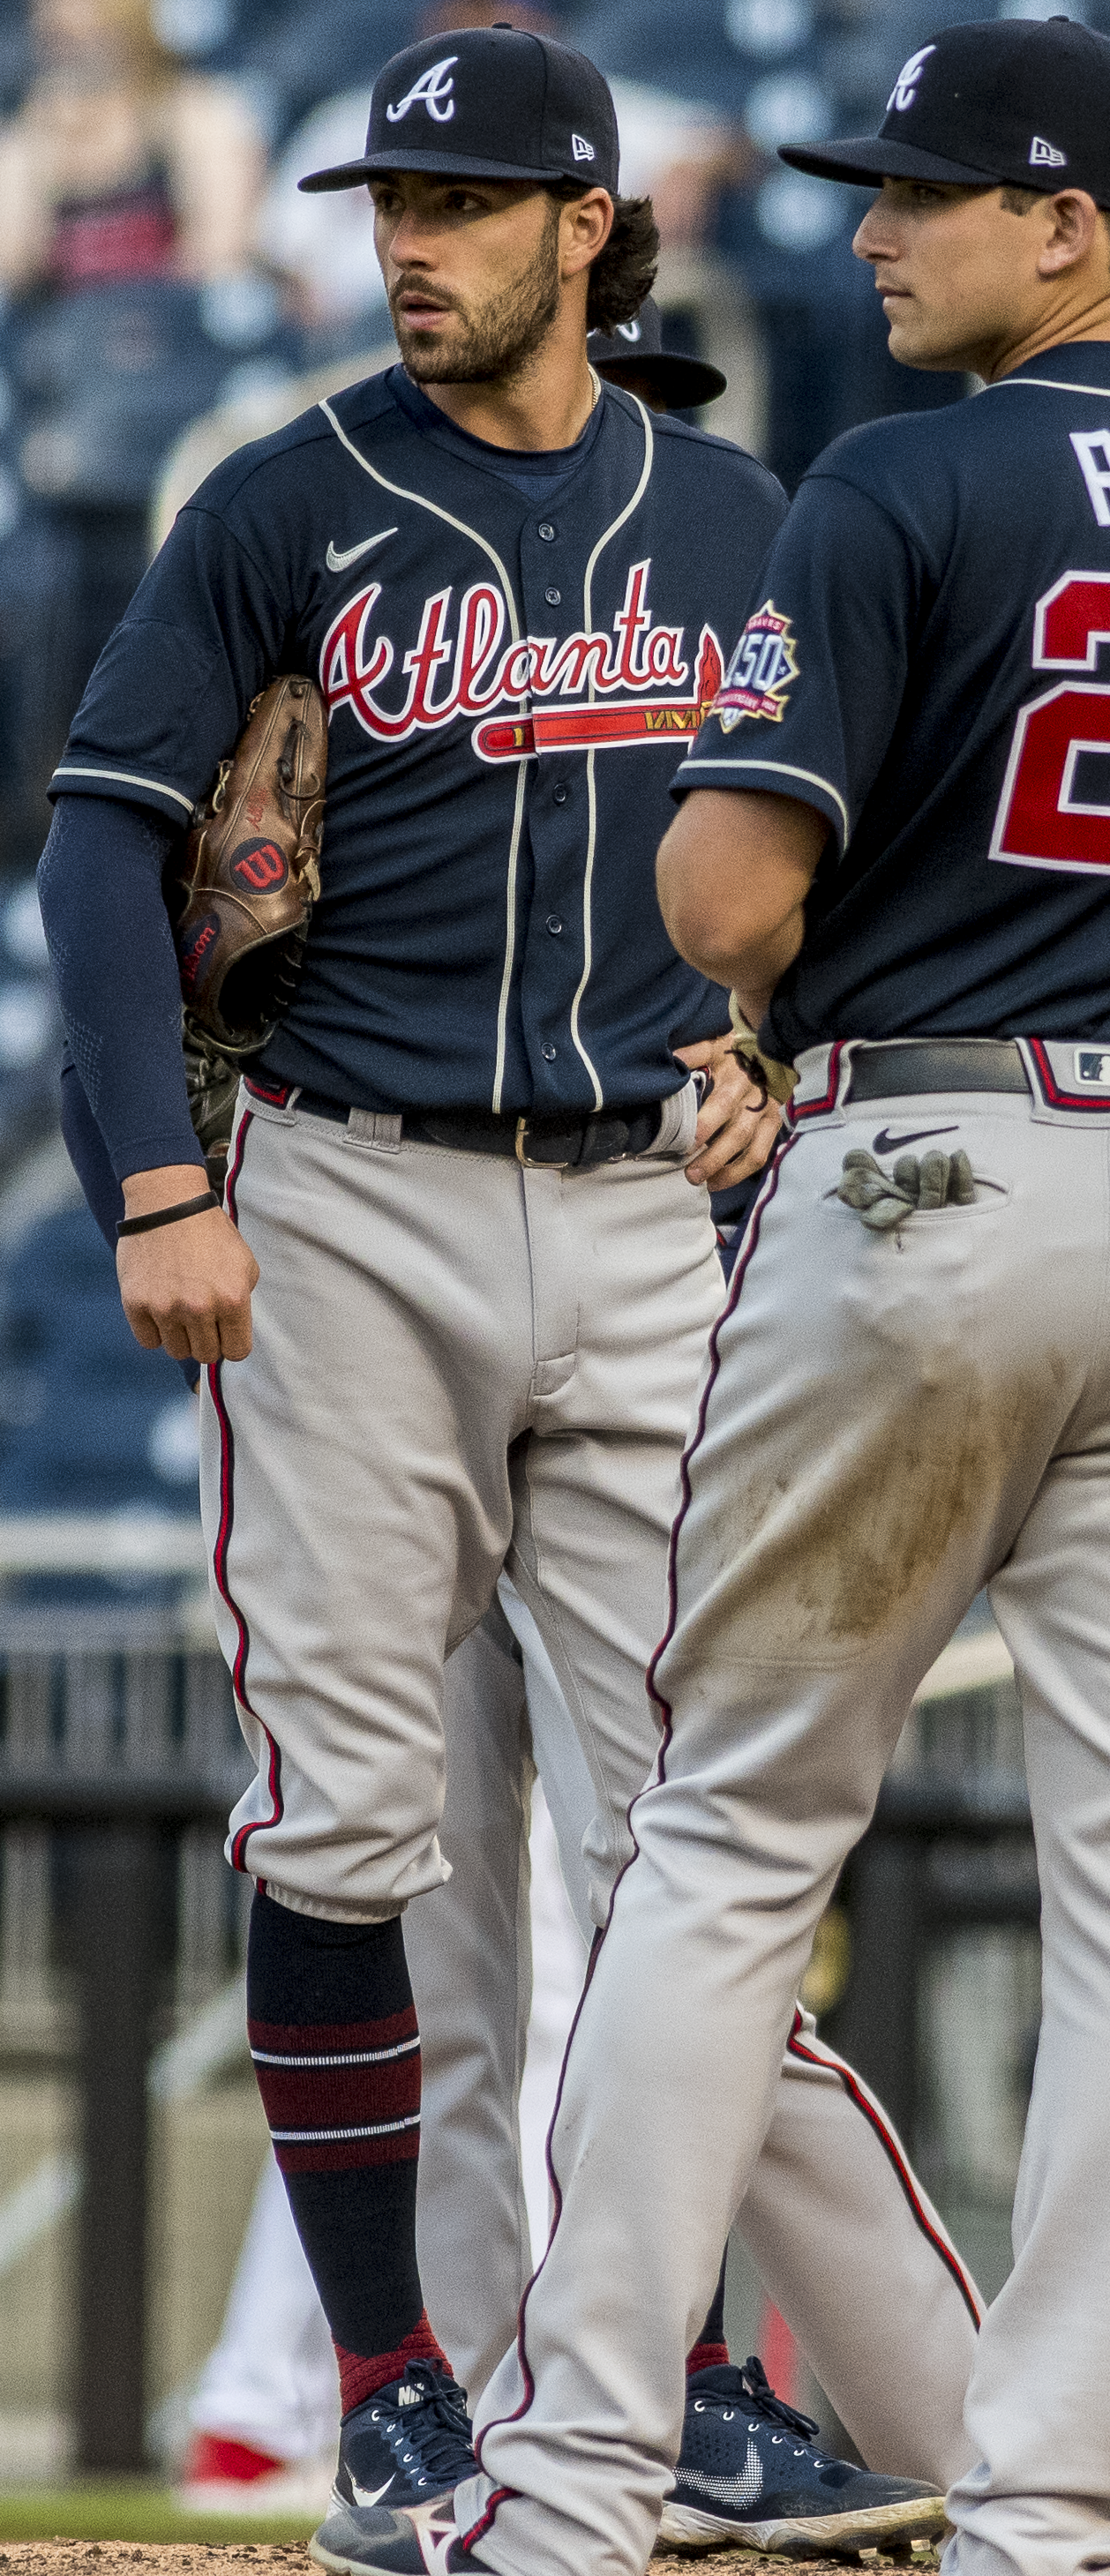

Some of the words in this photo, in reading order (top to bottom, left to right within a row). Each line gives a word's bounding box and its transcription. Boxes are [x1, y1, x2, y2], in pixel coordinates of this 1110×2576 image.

[386, 56, 458, 122] A
[319, 558, 686, 743] Atlanta
[722, 633, 784, 691] 150
[234, 844, 285, 889] W
